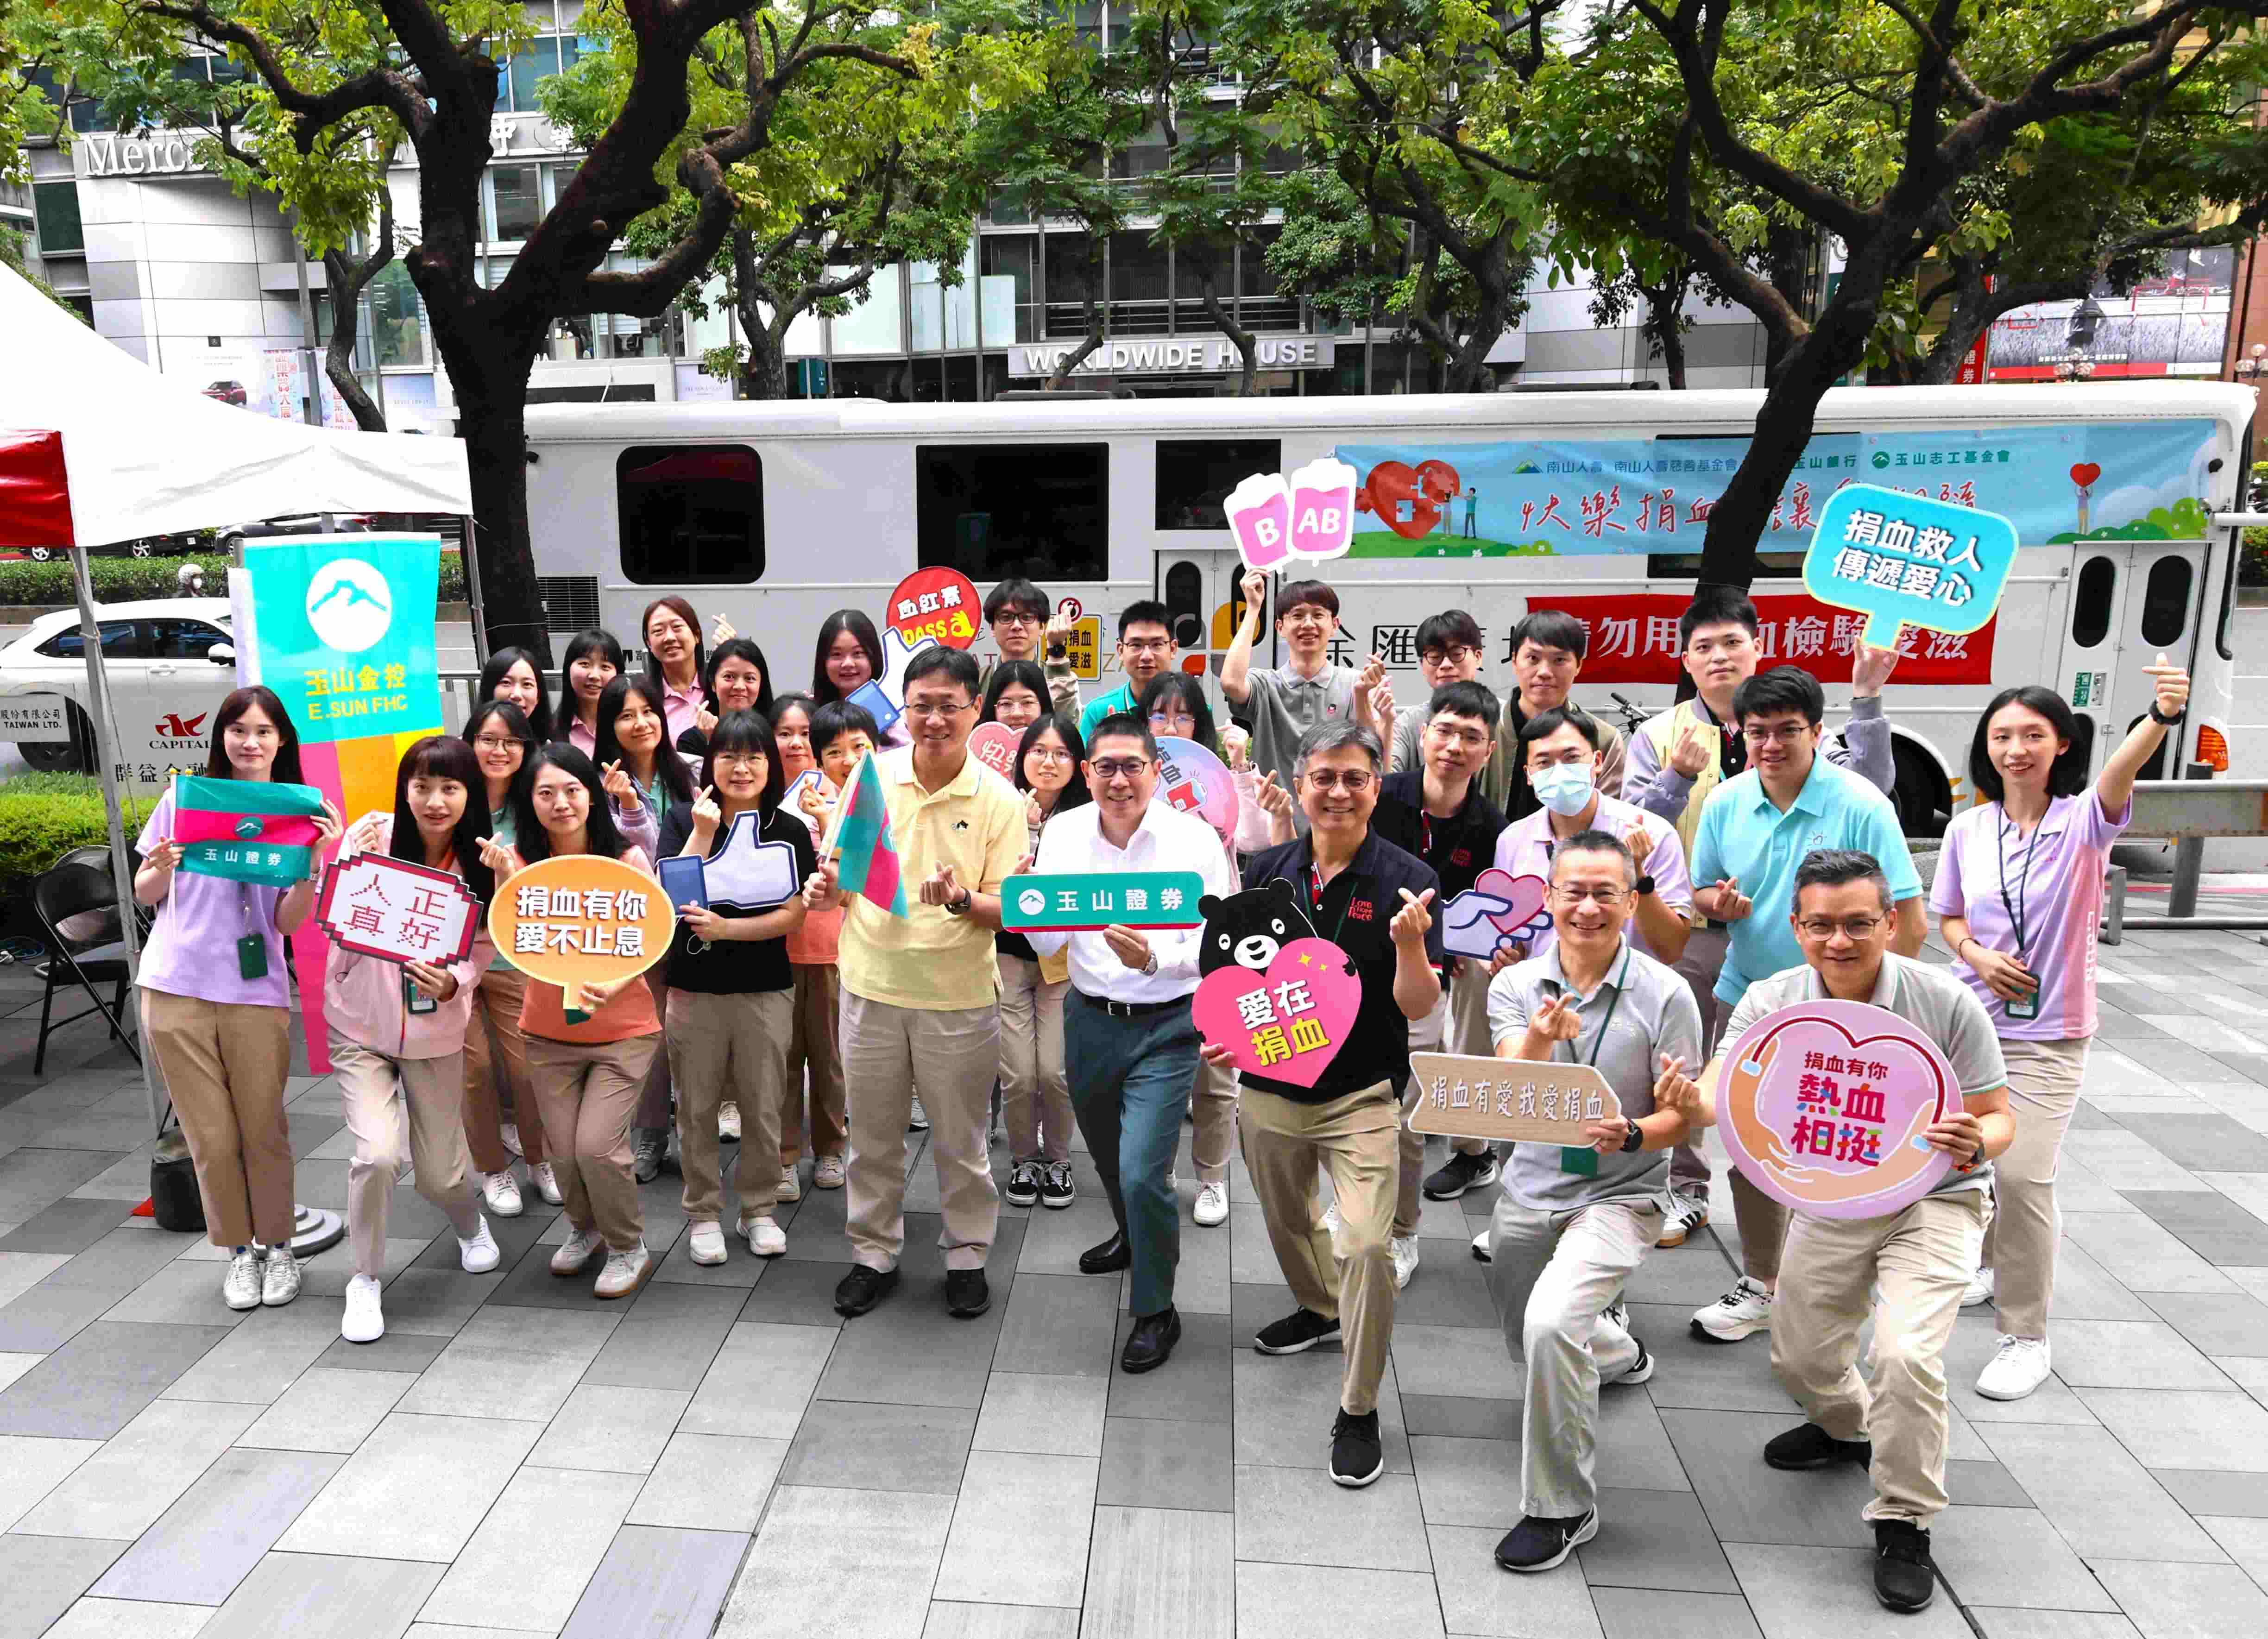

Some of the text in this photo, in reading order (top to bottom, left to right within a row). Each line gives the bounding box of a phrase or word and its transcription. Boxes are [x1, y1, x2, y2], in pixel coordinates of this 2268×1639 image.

[1218, 340, 1316, 365] HUSE
[1547, 460, 1602, 474] 南山人壽
[1614, 459, 1738, 475] 南山人壽慈善基金會
[1895, 449, 2010, 466] 玉山志工基金會
[1254, 517, 1280, 548] B
[1297, 507, 1342, 534] AB
[1843, 509, 1983, 572] 捐血救人
[1831, 546, 1973, 607] 傳遞愛心
[1580, 615, 1970, 660] 勿用血檢驗愛滋
[304, 662, 408, 696] 玉山金控
[372, 694, 408, 714] FHC
[149, 740, 212, 749] CAPITAL
[204, 848, 282, 867] 玉山證券
[516, 885, 648, 921] 捐血有你
[1056, 888, 1183, 912] 玉山證券
[515, 922, 646, 957] 愛不止息
[1235, 979, 1316, 1031] 愛在
[1251, 1018, 1330, 1066] 捐血
[1804, 1051, 1889, 1080] 捐血有你
[1430, 1075, 1605, 1123] 捐血有愛我愛捐血
[1796, 1073, 1886, 1124] 熱血
[1790, 1116, 1883, 1166] 相挺
